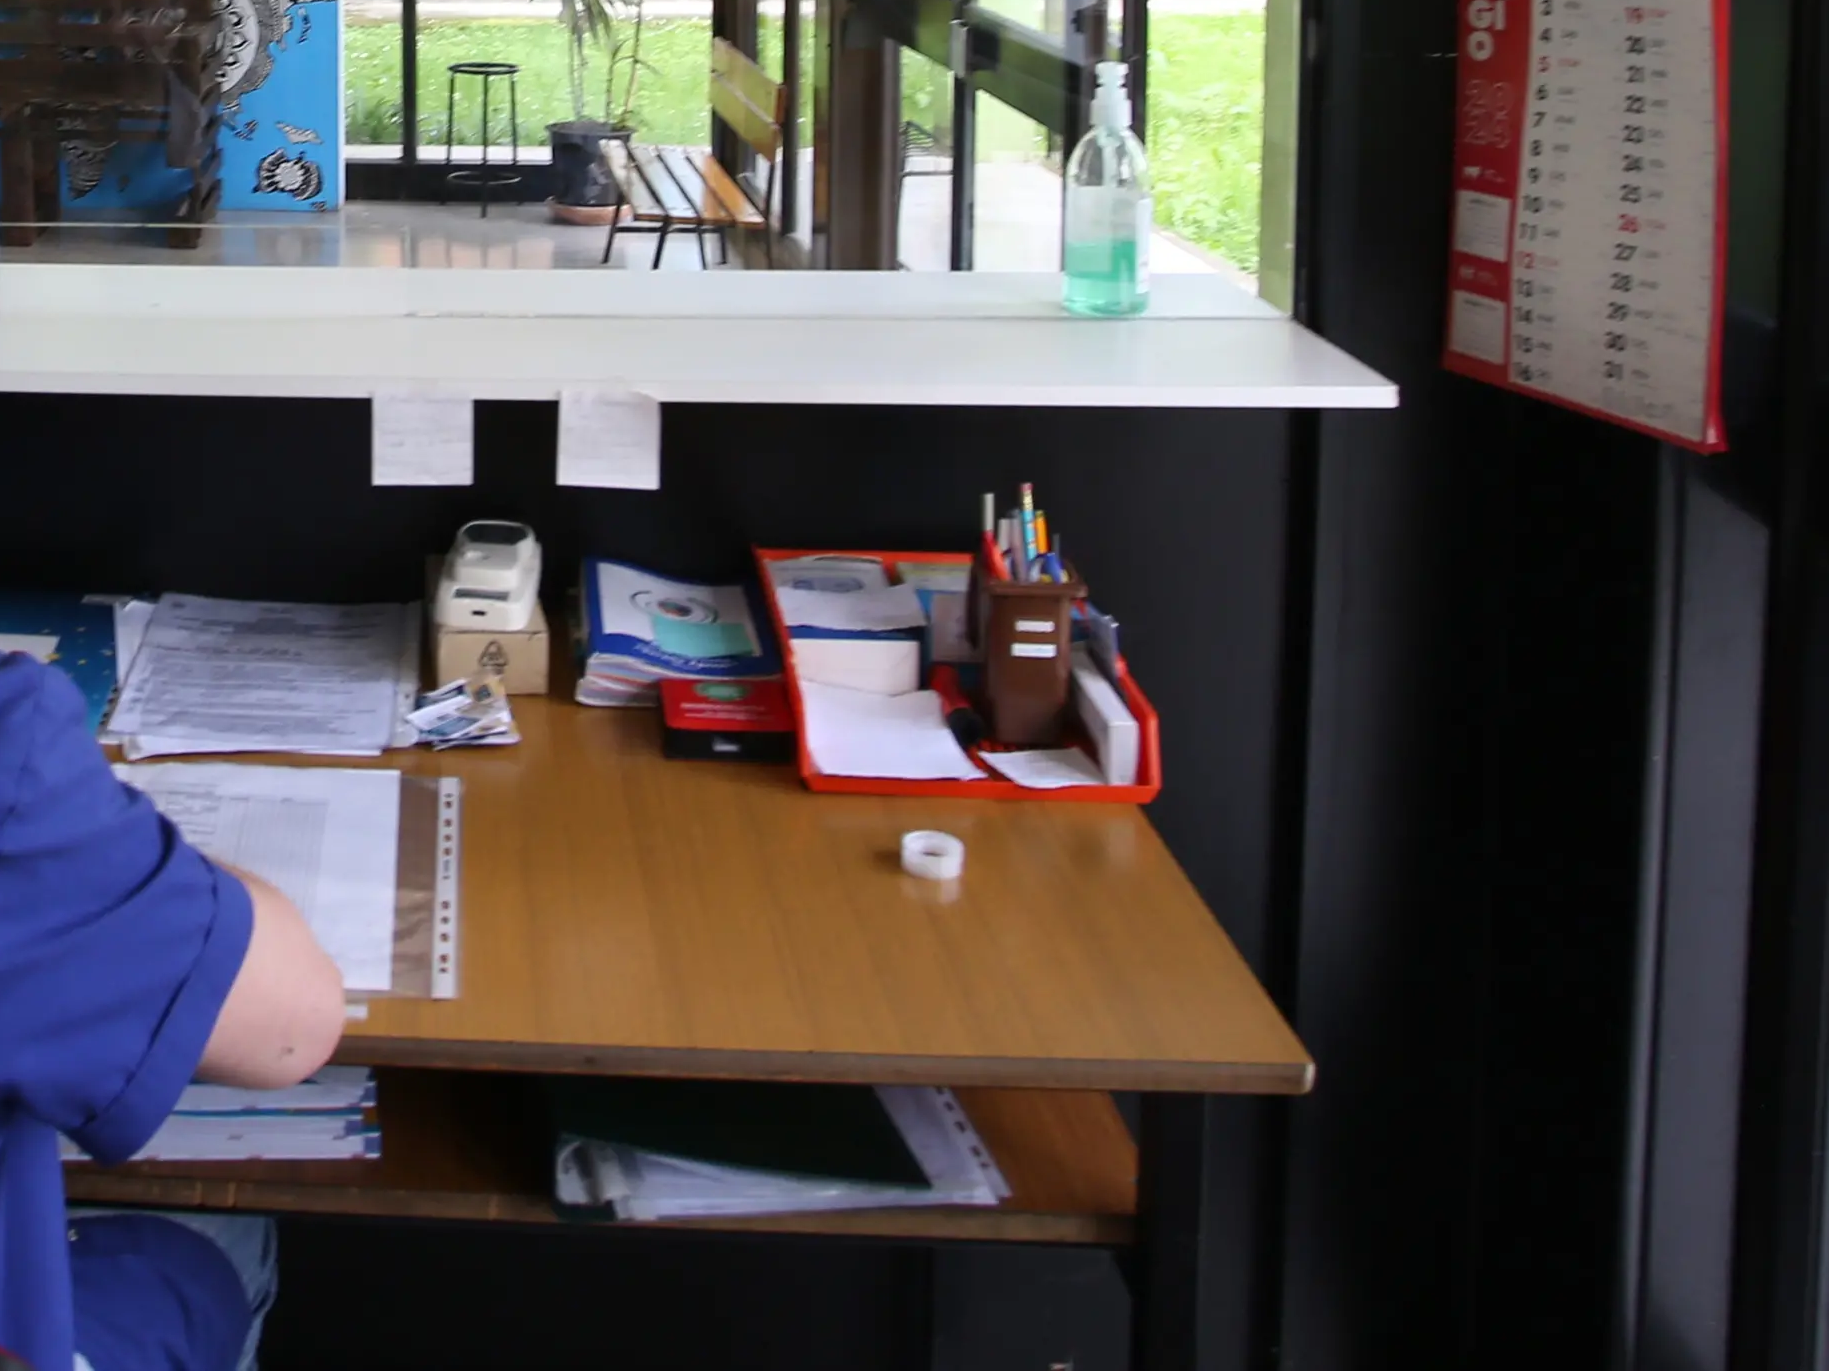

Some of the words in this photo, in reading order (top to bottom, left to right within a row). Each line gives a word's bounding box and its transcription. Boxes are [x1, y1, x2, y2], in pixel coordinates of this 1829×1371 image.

[1539, 0, 1553, 16] 3
[1538, 27, 1552, 44] 4
[1467, 30, 1494, 61] O
[1537, 55, 1550, 73] 5
[1626, 65, 1645, 84] 21
[1534, 83, 1548, 101] 6
[1624, 94, 1646, 114] 22
[1532, 111, 1547, 128] 7
[1622, 124, 1645, 144] 23
[1529, 139, 1542, 157] 8
[1622, 154, 1644, 173] 24
[1527, 166, 1542, 185] 9
[1619, 183, 1642, 203] 25
[1520, 222, 1537, 241] 11
[1617, 213, 1640, 233] 26
[1612, 242, 1639, 261] 27
[1610, 272, 1633, 293] 28
[1513, 306, 1533, 325] 14
[1605, 301, 1630, 322] 29
